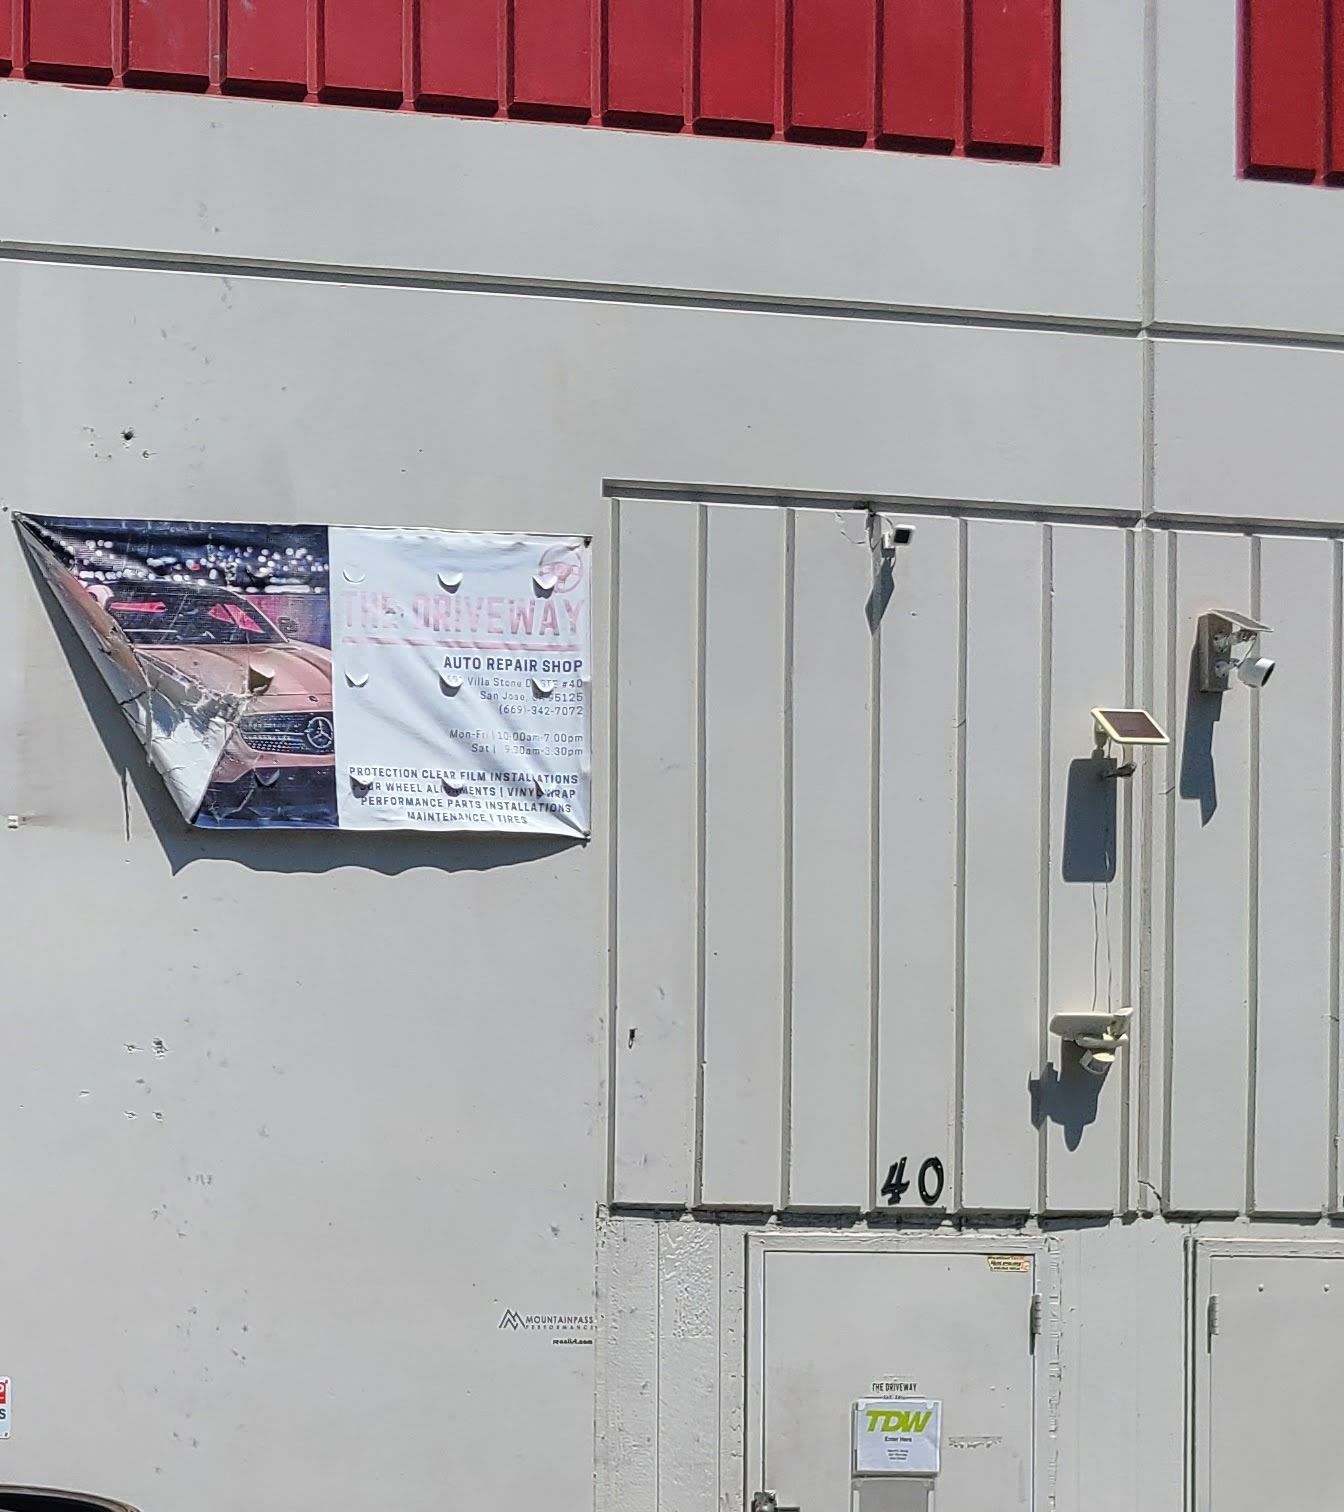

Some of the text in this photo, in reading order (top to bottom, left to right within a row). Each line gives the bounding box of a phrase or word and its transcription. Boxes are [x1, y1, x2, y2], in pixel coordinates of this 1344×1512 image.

[340, 591, 584, 636] THE DRIVEWAY
[443, 656, 583, 673] AUTO REPAIR SHOP
[467, 676, 490, 686] Villa
[562, 679, 583, 688] #40
[480, 690, 499, 700] San
[471, 743, 489, 753] Sat
[349, 766, 418, 779] PROTECTION
[421, 769, 456, 780] CLEAR
[460, 771, 486, 781] FILM
[385, 782, 423, 793] WHEEL
[507, 787, 543, 797] VINYL
[360, 796, 572, 813] PERFORMANCE PARTS INSTALLATIONS
[407, 811, 487, 823] MAINTENANCE
[496, 814, 529, 825] TIRES
[880, 1156, 944, 1206] 40
[525, 1315, 593, 1324] MOUNTAINPASS
[872, 1382, 917, 1392] THE DRIVEWAY
[865, 1409, 933, 1432] TDW
